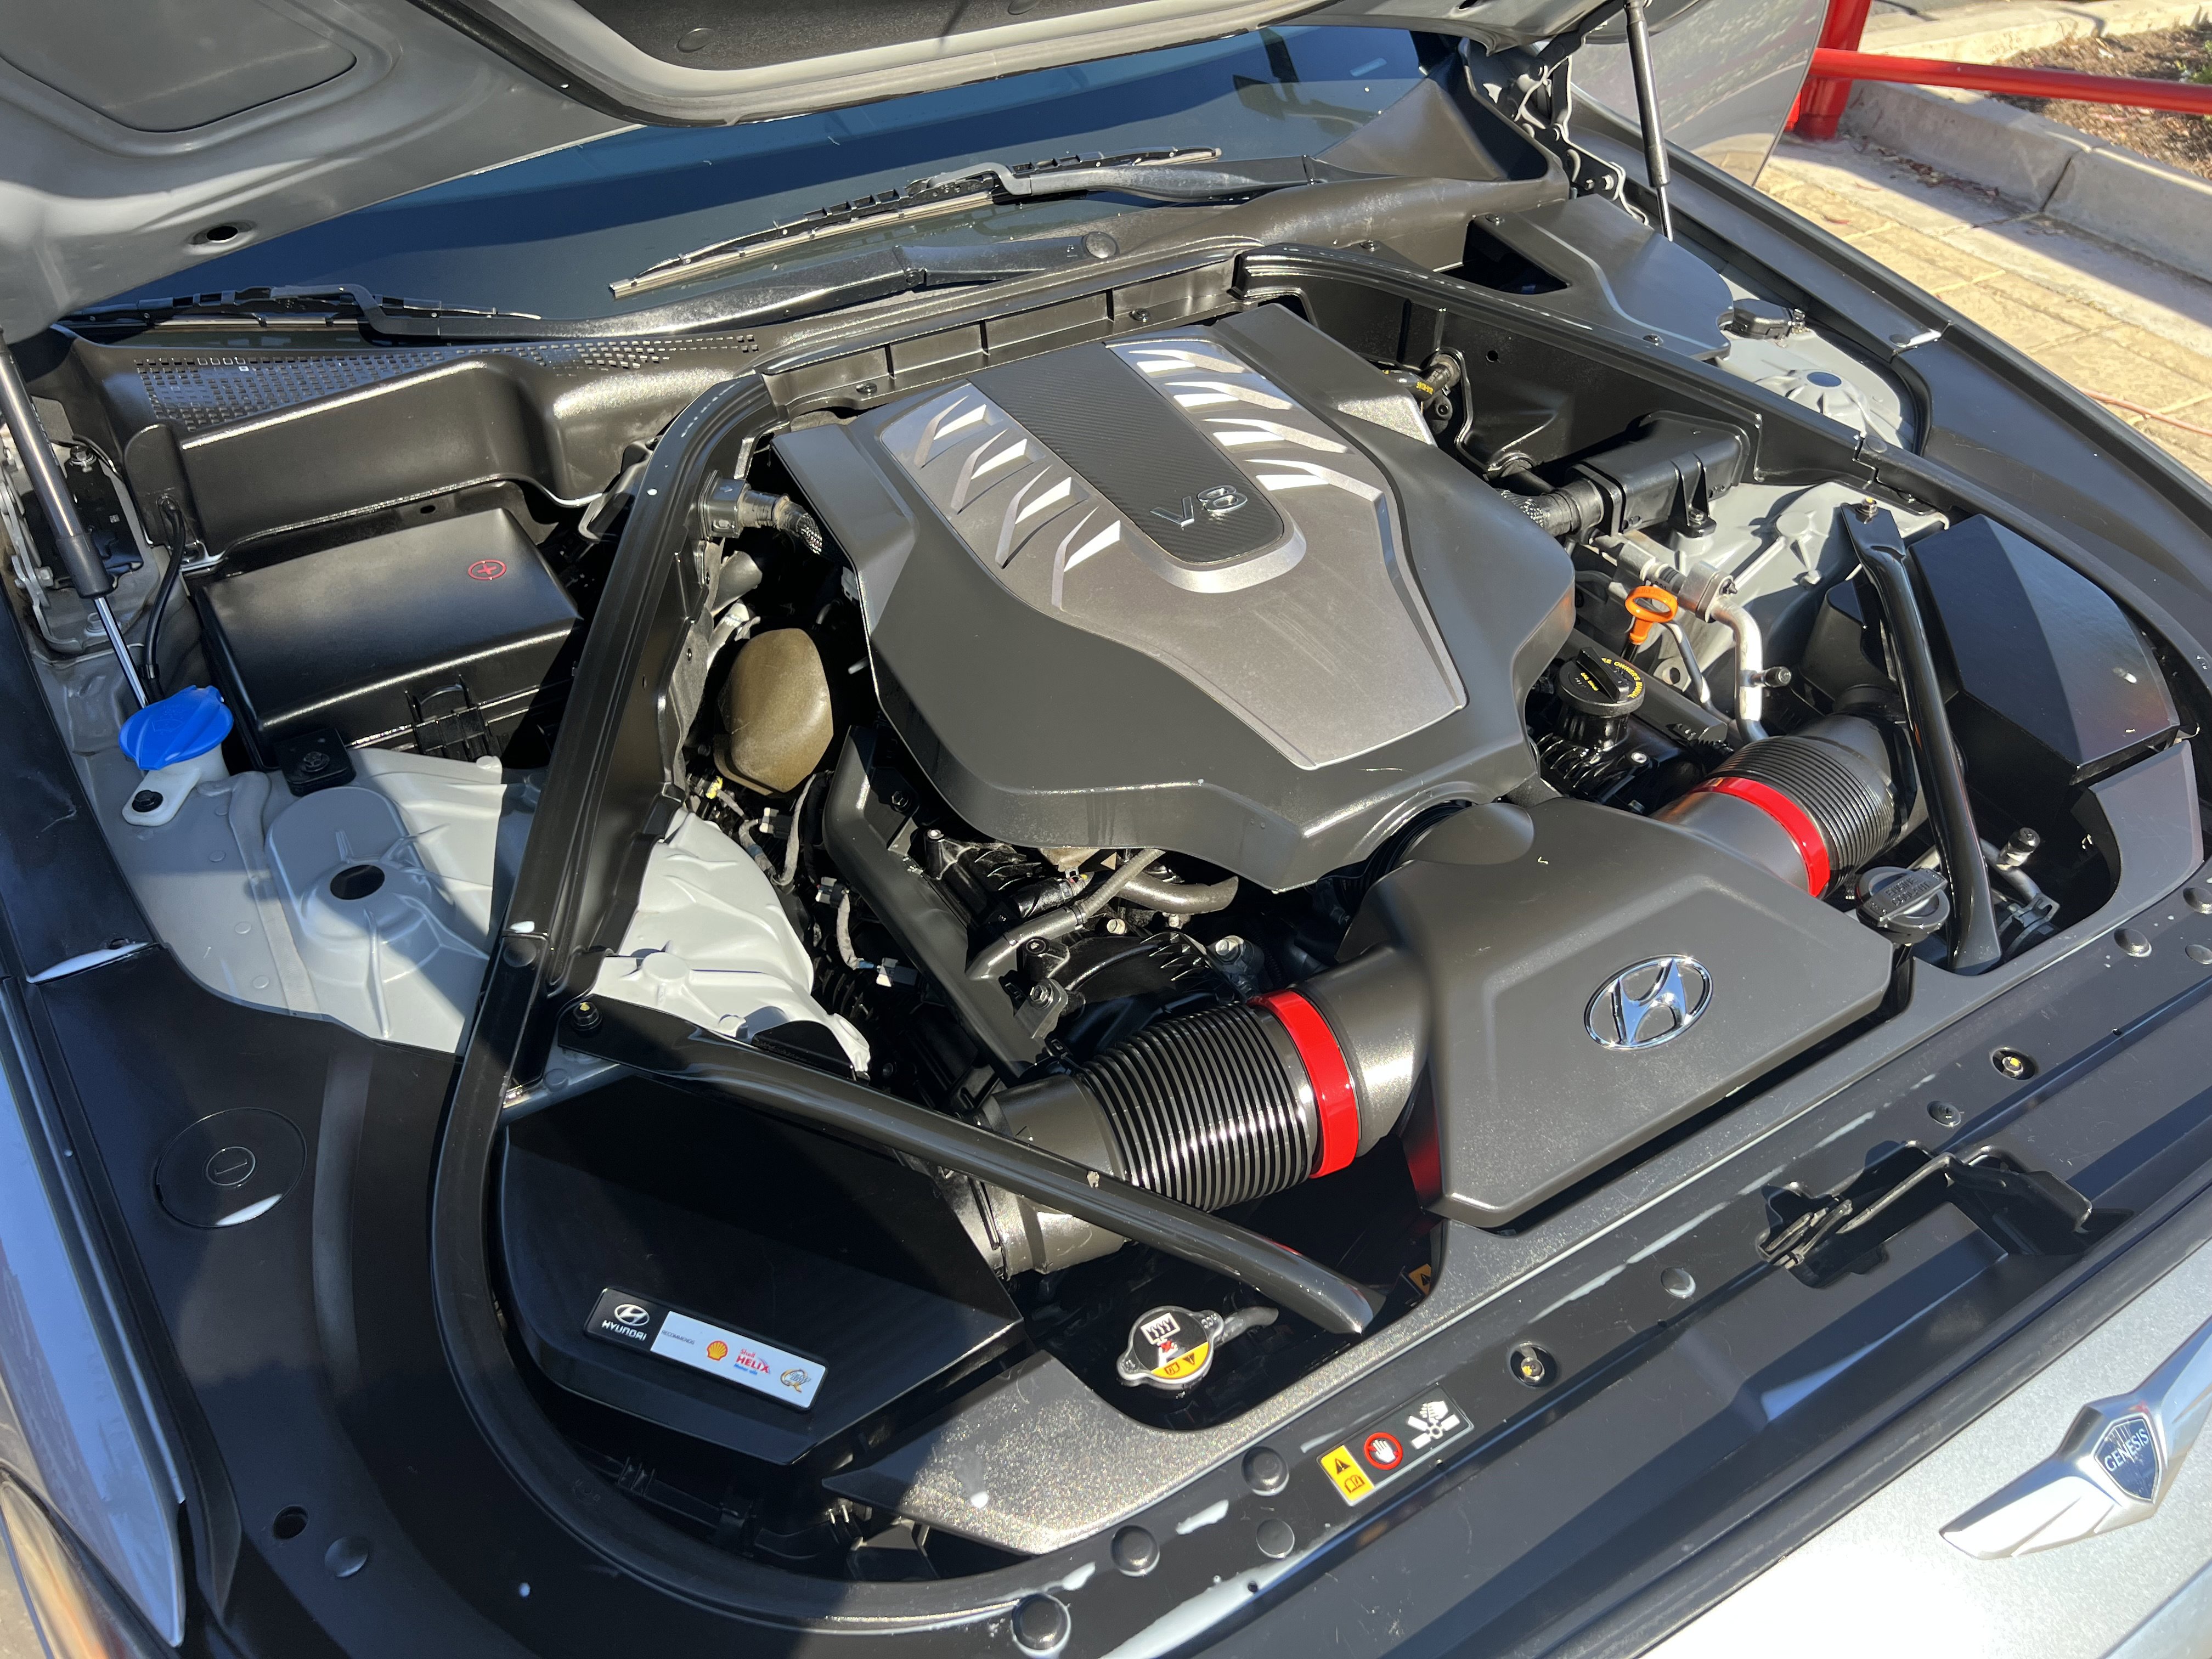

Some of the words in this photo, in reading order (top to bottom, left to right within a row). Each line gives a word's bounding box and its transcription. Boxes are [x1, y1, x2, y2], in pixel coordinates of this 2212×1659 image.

[1150, 484, 1248, 525] V8
[1884, 876, 1918, 897] ENGINE
[1891, 881, 1930, 906] COOLANT
[601, 1319, 647, 1341] HYUNDAI
[661, 1329, 695, 1345] RECOMMENDS
[740, 1348, 756, 1358] Shell
[736, 1355, 770, 1373] HELIX
[2104, 1428, 2149, 1471] GENESIS
